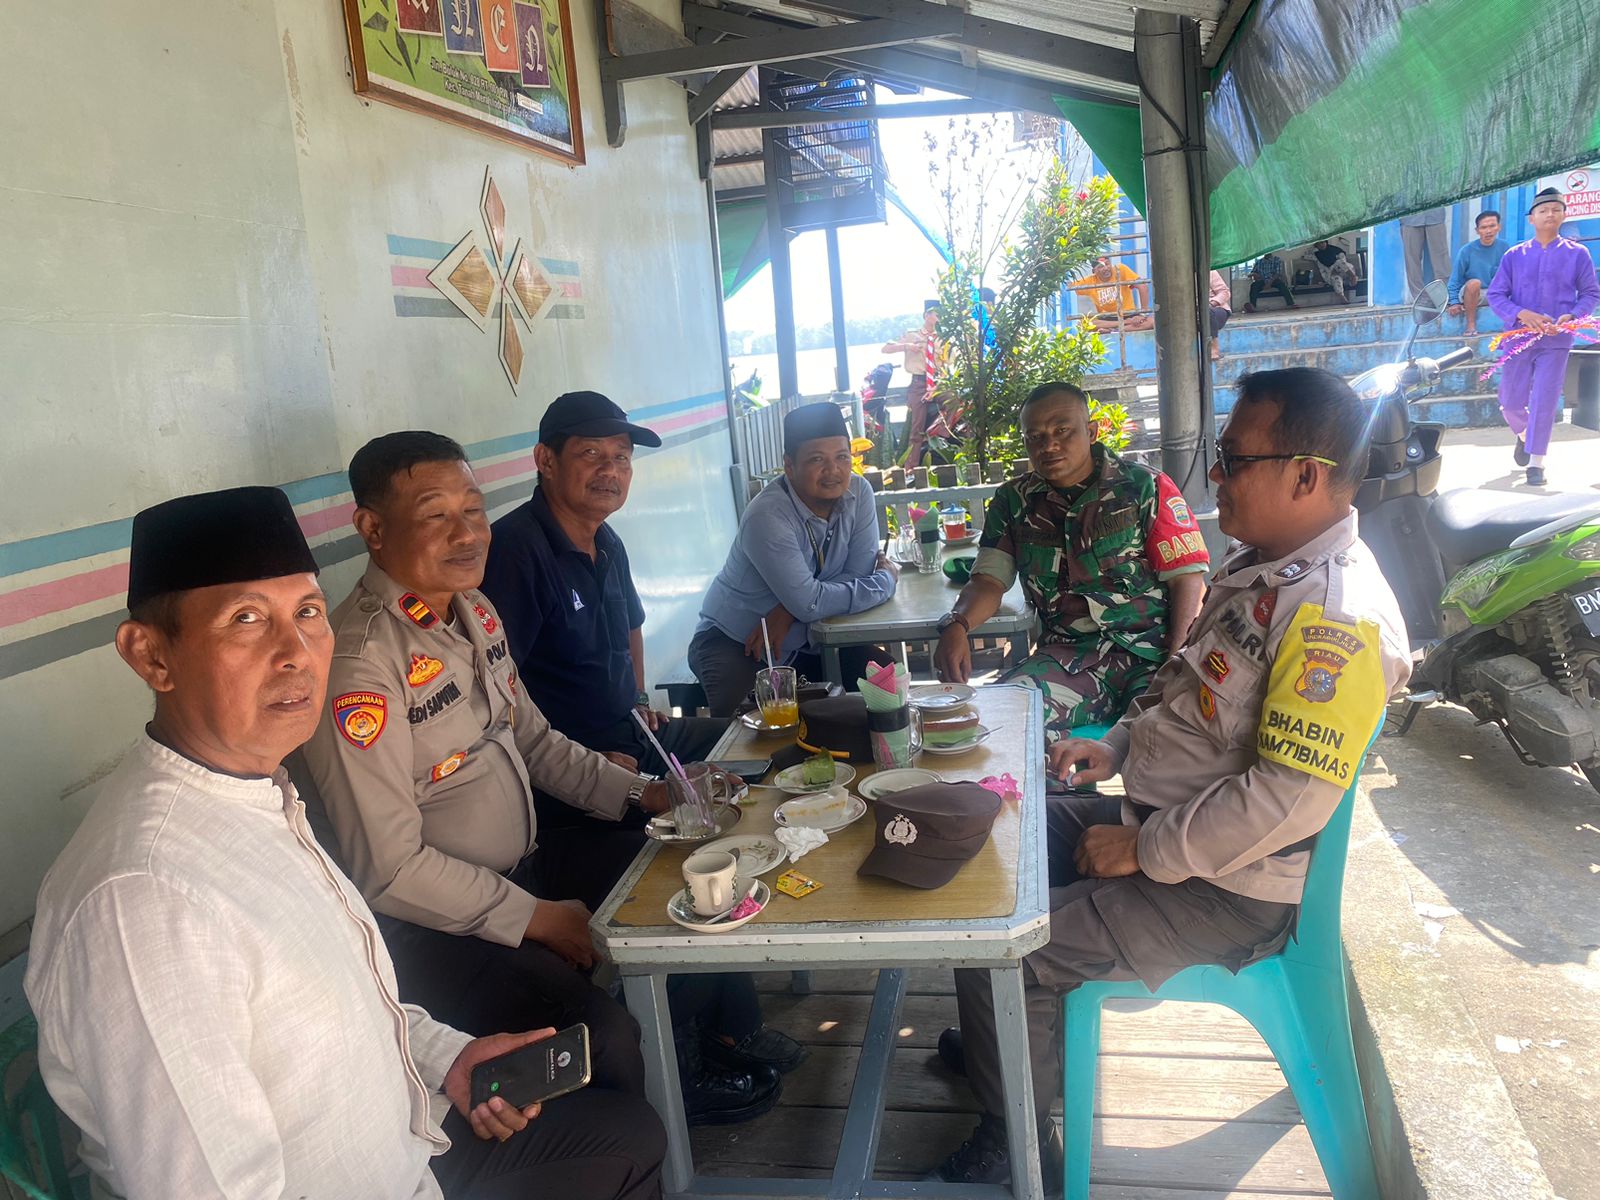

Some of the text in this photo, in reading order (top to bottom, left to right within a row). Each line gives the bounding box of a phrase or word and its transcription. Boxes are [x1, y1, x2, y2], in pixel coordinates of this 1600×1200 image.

[1564, 192, 1600, 205] LARANG
[1565, 204, 1590, 216] NCING
[1309, 628, 1358, 647] POLRES
[1314, 651, 1341, 663] RIAU
[336, 695, 384, 709] PERENCANAAN
[1267, 710, 1345, 750] BHABIN
[1258, 731, 1350, 780] KAMTIBMAS
